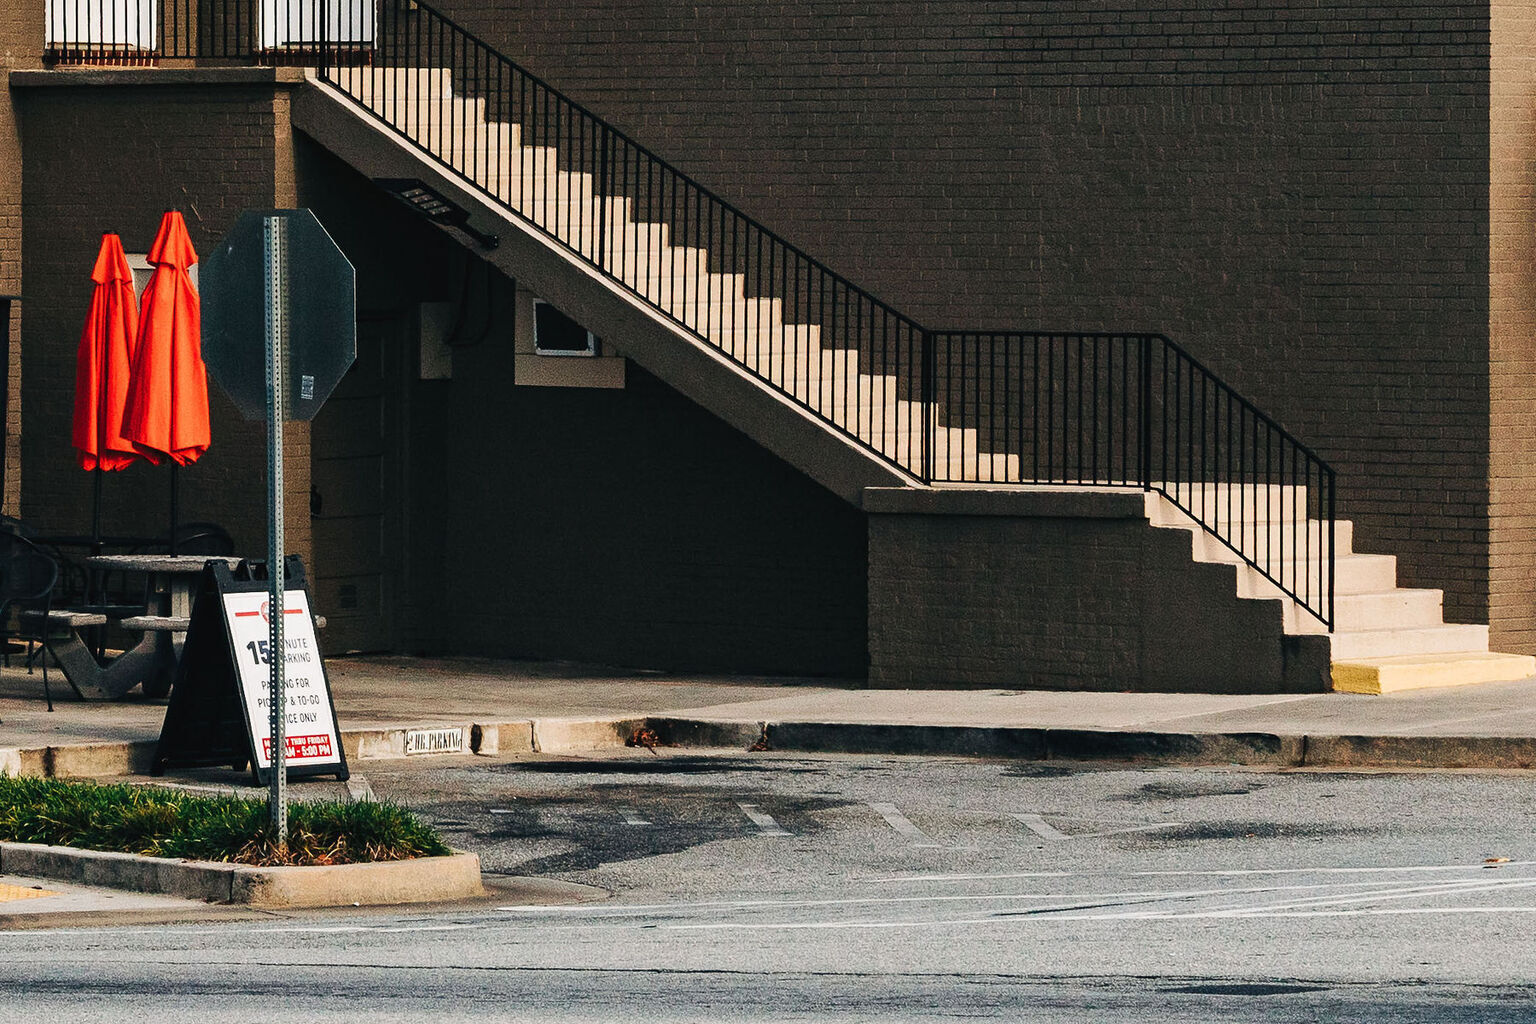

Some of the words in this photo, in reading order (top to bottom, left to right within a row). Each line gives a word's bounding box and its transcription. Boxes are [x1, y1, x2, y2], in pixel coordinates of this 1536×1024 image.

[284, 638, 308, 649] NUTE
[246, 640, 270, 665] 15
[284, 652, 311, 664] ARKING
[296, 678, 310, 688] FOR
[297, 694, 320, 706] TO-GO
[300, 712, 318, 723] ONLY
[318, 744, 331, 756] PM
